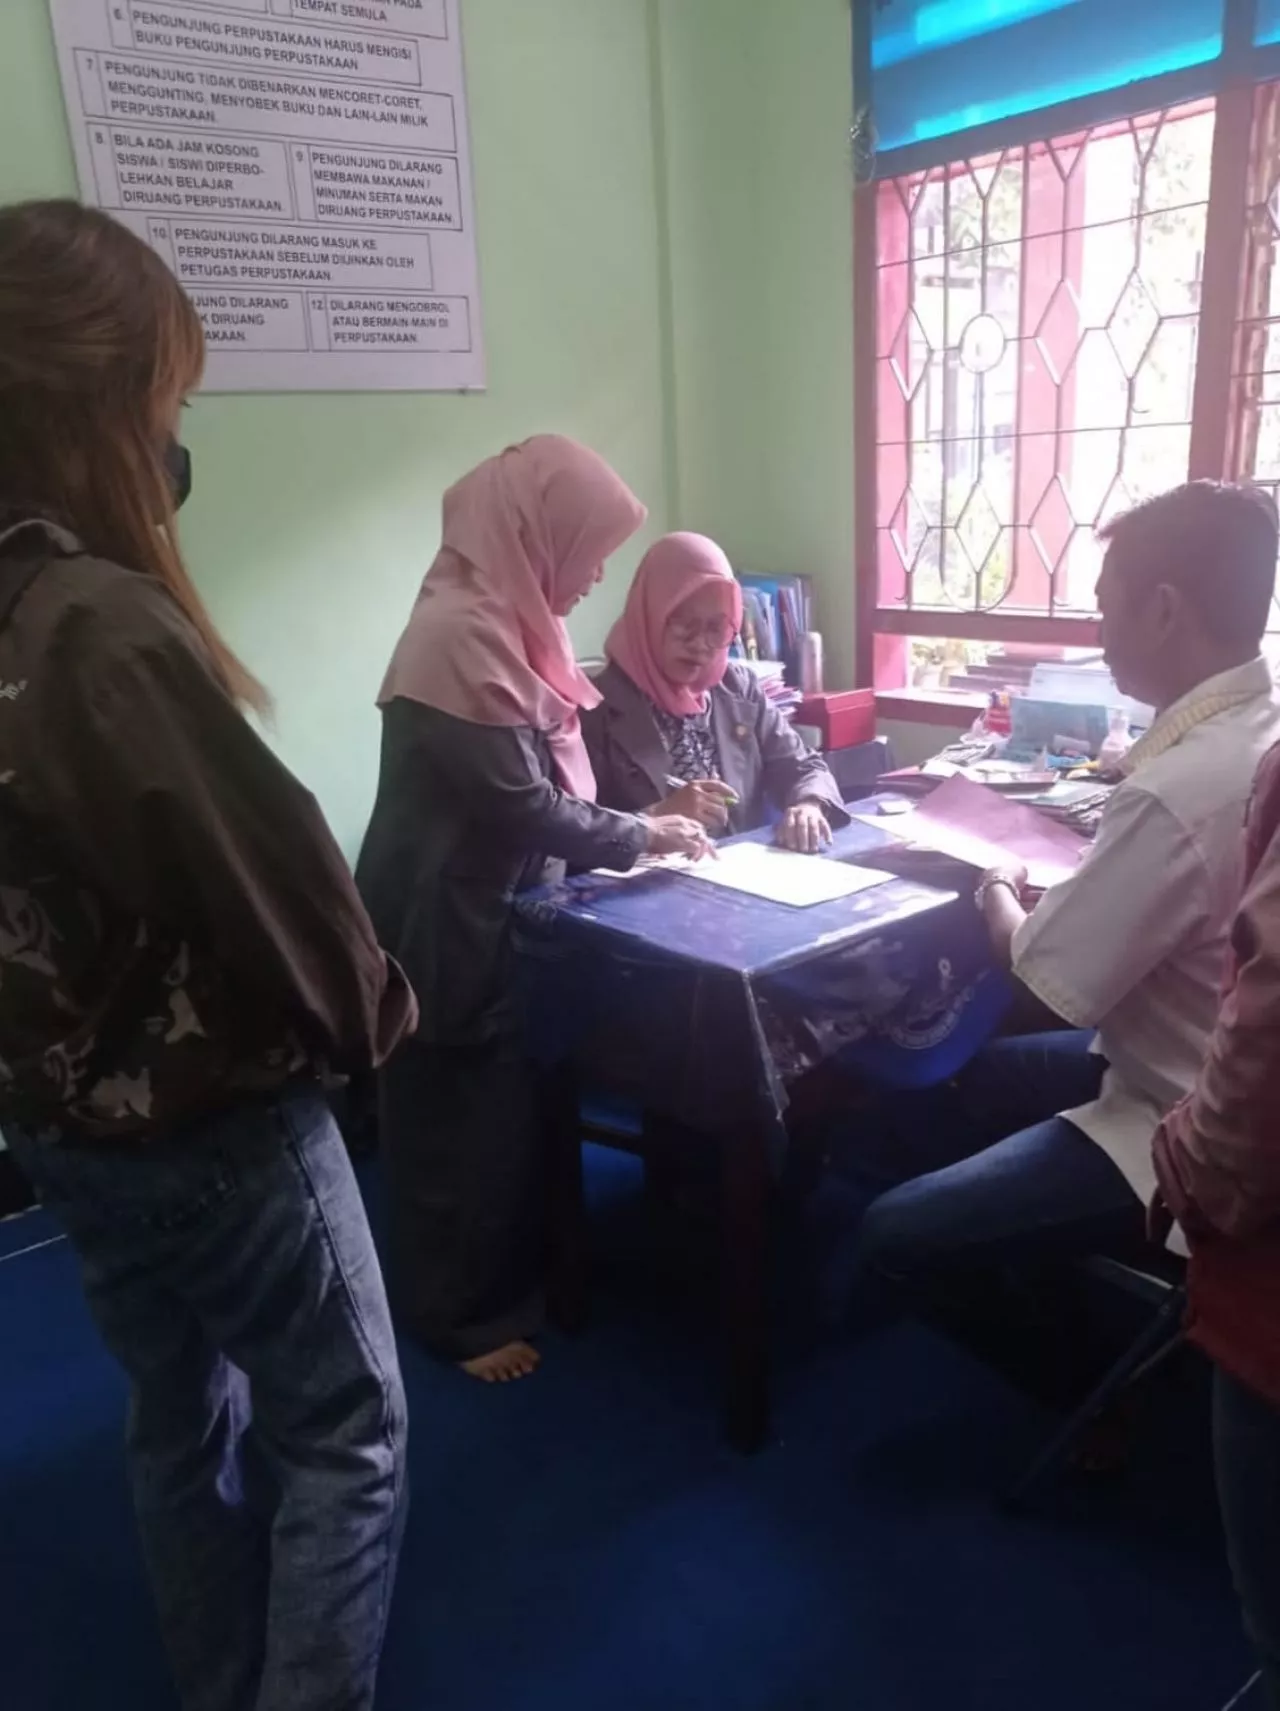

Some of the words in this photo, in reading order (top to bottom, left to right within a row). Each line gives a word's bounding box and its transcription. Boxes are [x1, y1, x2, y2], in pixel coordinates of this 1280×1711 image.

[294, 0, 338, 14] TEMPAT
[341, 4, 387, 21] SEMULA
[133, 10, 221, 35] PENGUNJUNG
[225, 24, 322, 48] PERPUSTAKAAN
[324, 39, 363, 54] HARUS
[366, 45, 412, 60] MENGISI
[136, 30, 173, 46] BUKU
[176, 35, 262, 60] PENGUNJUNG
[264, 49, 359, 70] PERPUSTAKAAN
[105, 60, 196, 84] PENGUNJUNG
[199, 72, 235, 88] TIDAK
[238, 78, 317, 98] DIBENARKAN
[210, 92, 280, 111] MENYOBEK
[282, 100, 315, 116] BUKU
[318, 104, 342, 118] DAN
[344, 107, 398, 125] LAIN-LAIN
[400, 113, 429, 128] MILIK
[114, 134, 145, 148] BILA
[147, 137, 174, 151] ADA
[177, 140, 203, 153] JAM
[206, 142, 260, 158] KOSONG
[117, 152, 158, 168] SISWA
[168, 157, 203, 172] SISWI
[312, 151, 387, 170] PENGUNJUNG
[389, 158, 443, 175] DILARANG
[120, 171, 172, 188] LEHKAN
[176, 175, 234, 191] BELAJAR
[314, 169, 370, 185] MEMBAWA
[372, 174, 425, 188] MAKANAN
[123, 189, 182, 206] DIRUANG
[316, 186, 366, 201] MINUMAN
[368, 191, 402, 204] SERTA
[405, 193, 443, 206] MAKAN
[318, 203, 367, 219] DIRUANG
[175, 228, 259, 244] PENGUNJUNG
[261, 232, 319, 247] DILARANG
[321, 236, 360, 249] MASUK
[362, 239, 377, 250] KE
[178, 246, 275, 262] PERPUSTAKAAN
[277, 250, 330, 264] SEBELUM
[385, 256, 415, 268] OLEH
[180, 263, 238, 277] PETUGAS
[229, 296, 289, 309] DILARANG
[330, 300, 385, 312] DILARANG
[386, 301, 449, 313] MENGOBROL
[212, 313, 265, 326] DIRUANG
[332, 316, 359, 327] ATAU
